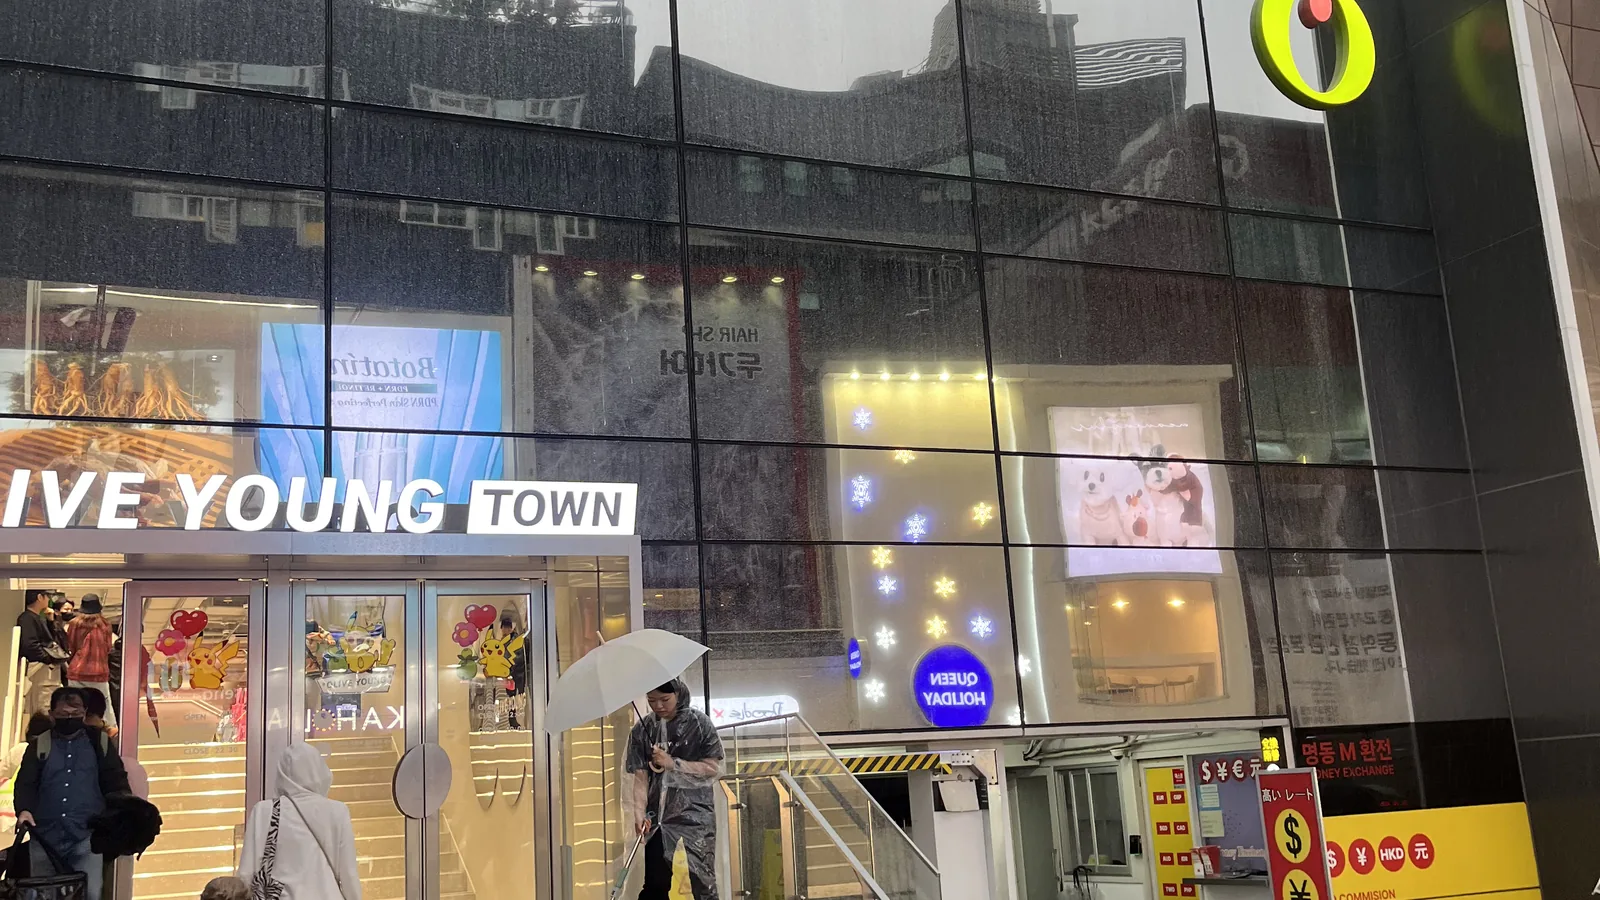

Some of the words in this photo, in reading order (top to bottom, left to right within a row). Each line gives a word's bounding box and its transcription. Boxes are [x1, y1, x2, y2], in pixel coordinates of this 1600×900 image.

[1, 469, 147, 530] IVE
[175, 472, 445, 534] YOUNG
[483, 488, 623, 527] TOWN
[326, 678, 353, 689] OLIVE
[356, 676, 386, 686] YOUNG
[184, 747, 208, 755] CLOSE
[1302, 741, 1336, 766] 명동
[1339, 741, 1357, 761] M
[1359, 738, 1393, 763] 환전
[1316, 768, 1341, 779] ONEY
[1343, 764, 1395, 778] EXCHANGE
[1262, 788, 1281, 803] 高い
[1285, 787, 1314, 802] レート
[1285, 813, 1301, 860] $
[1355, 847, 1367, 867] ¥
[1380, 847, 1404, 861] HKD
[1414, 842, 1429, 860] 元
[1338, 888, 1396, 900] COMMISION
